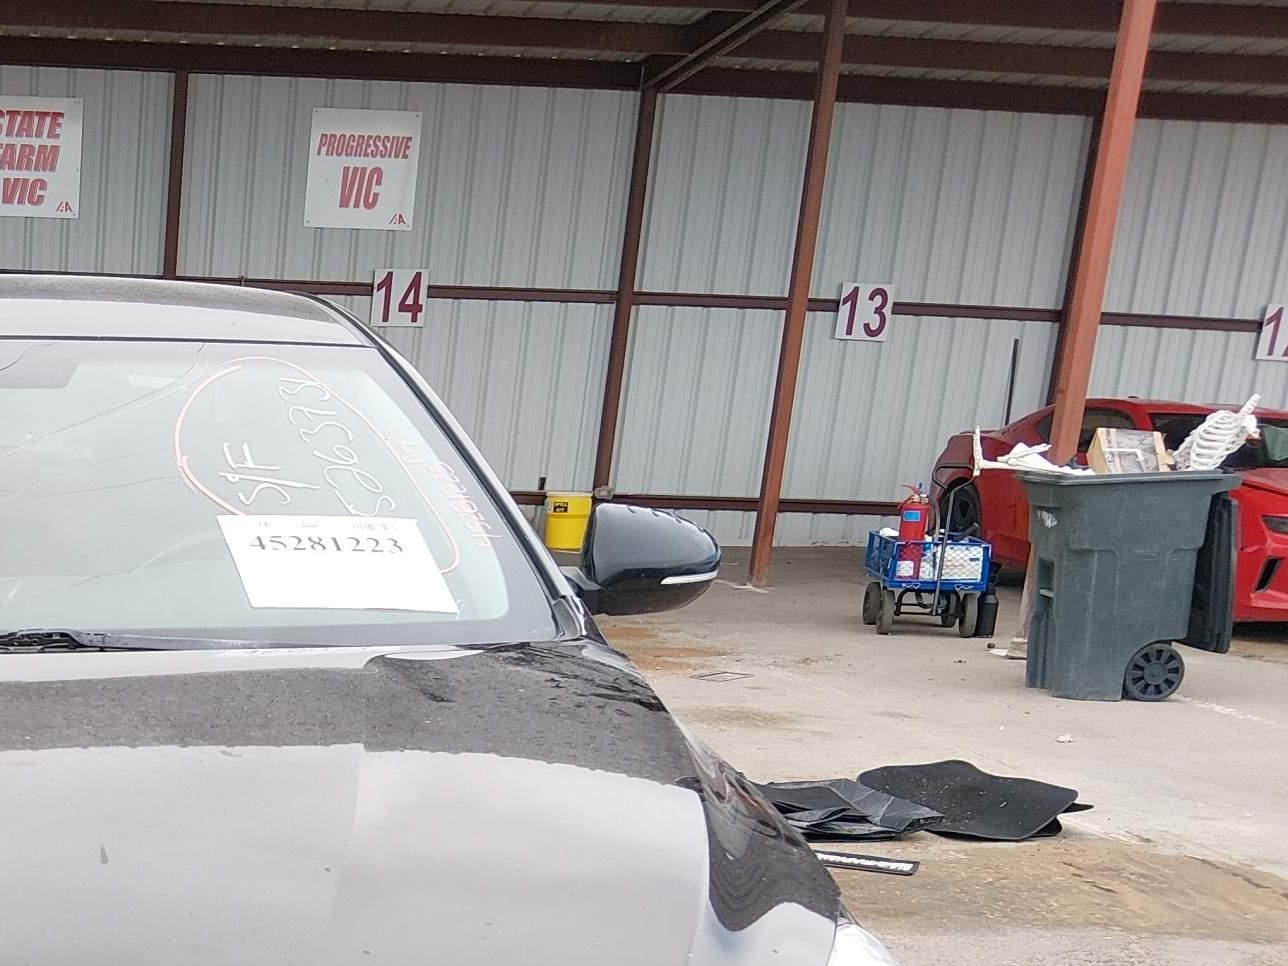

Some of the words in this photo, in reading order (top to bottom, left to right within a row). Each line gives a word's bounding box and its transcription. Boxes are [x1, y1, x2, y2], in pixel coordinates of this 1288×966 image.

[317, 133, 413, 159] PROGRESSIVE
[1, 177, 48, 206] VIC
[339, 166, 384, 210] VIC
[377, 271, 423, 322] 14
[842, 286, 889, 337] 13
[249, 535, 404, 554] 45281223
